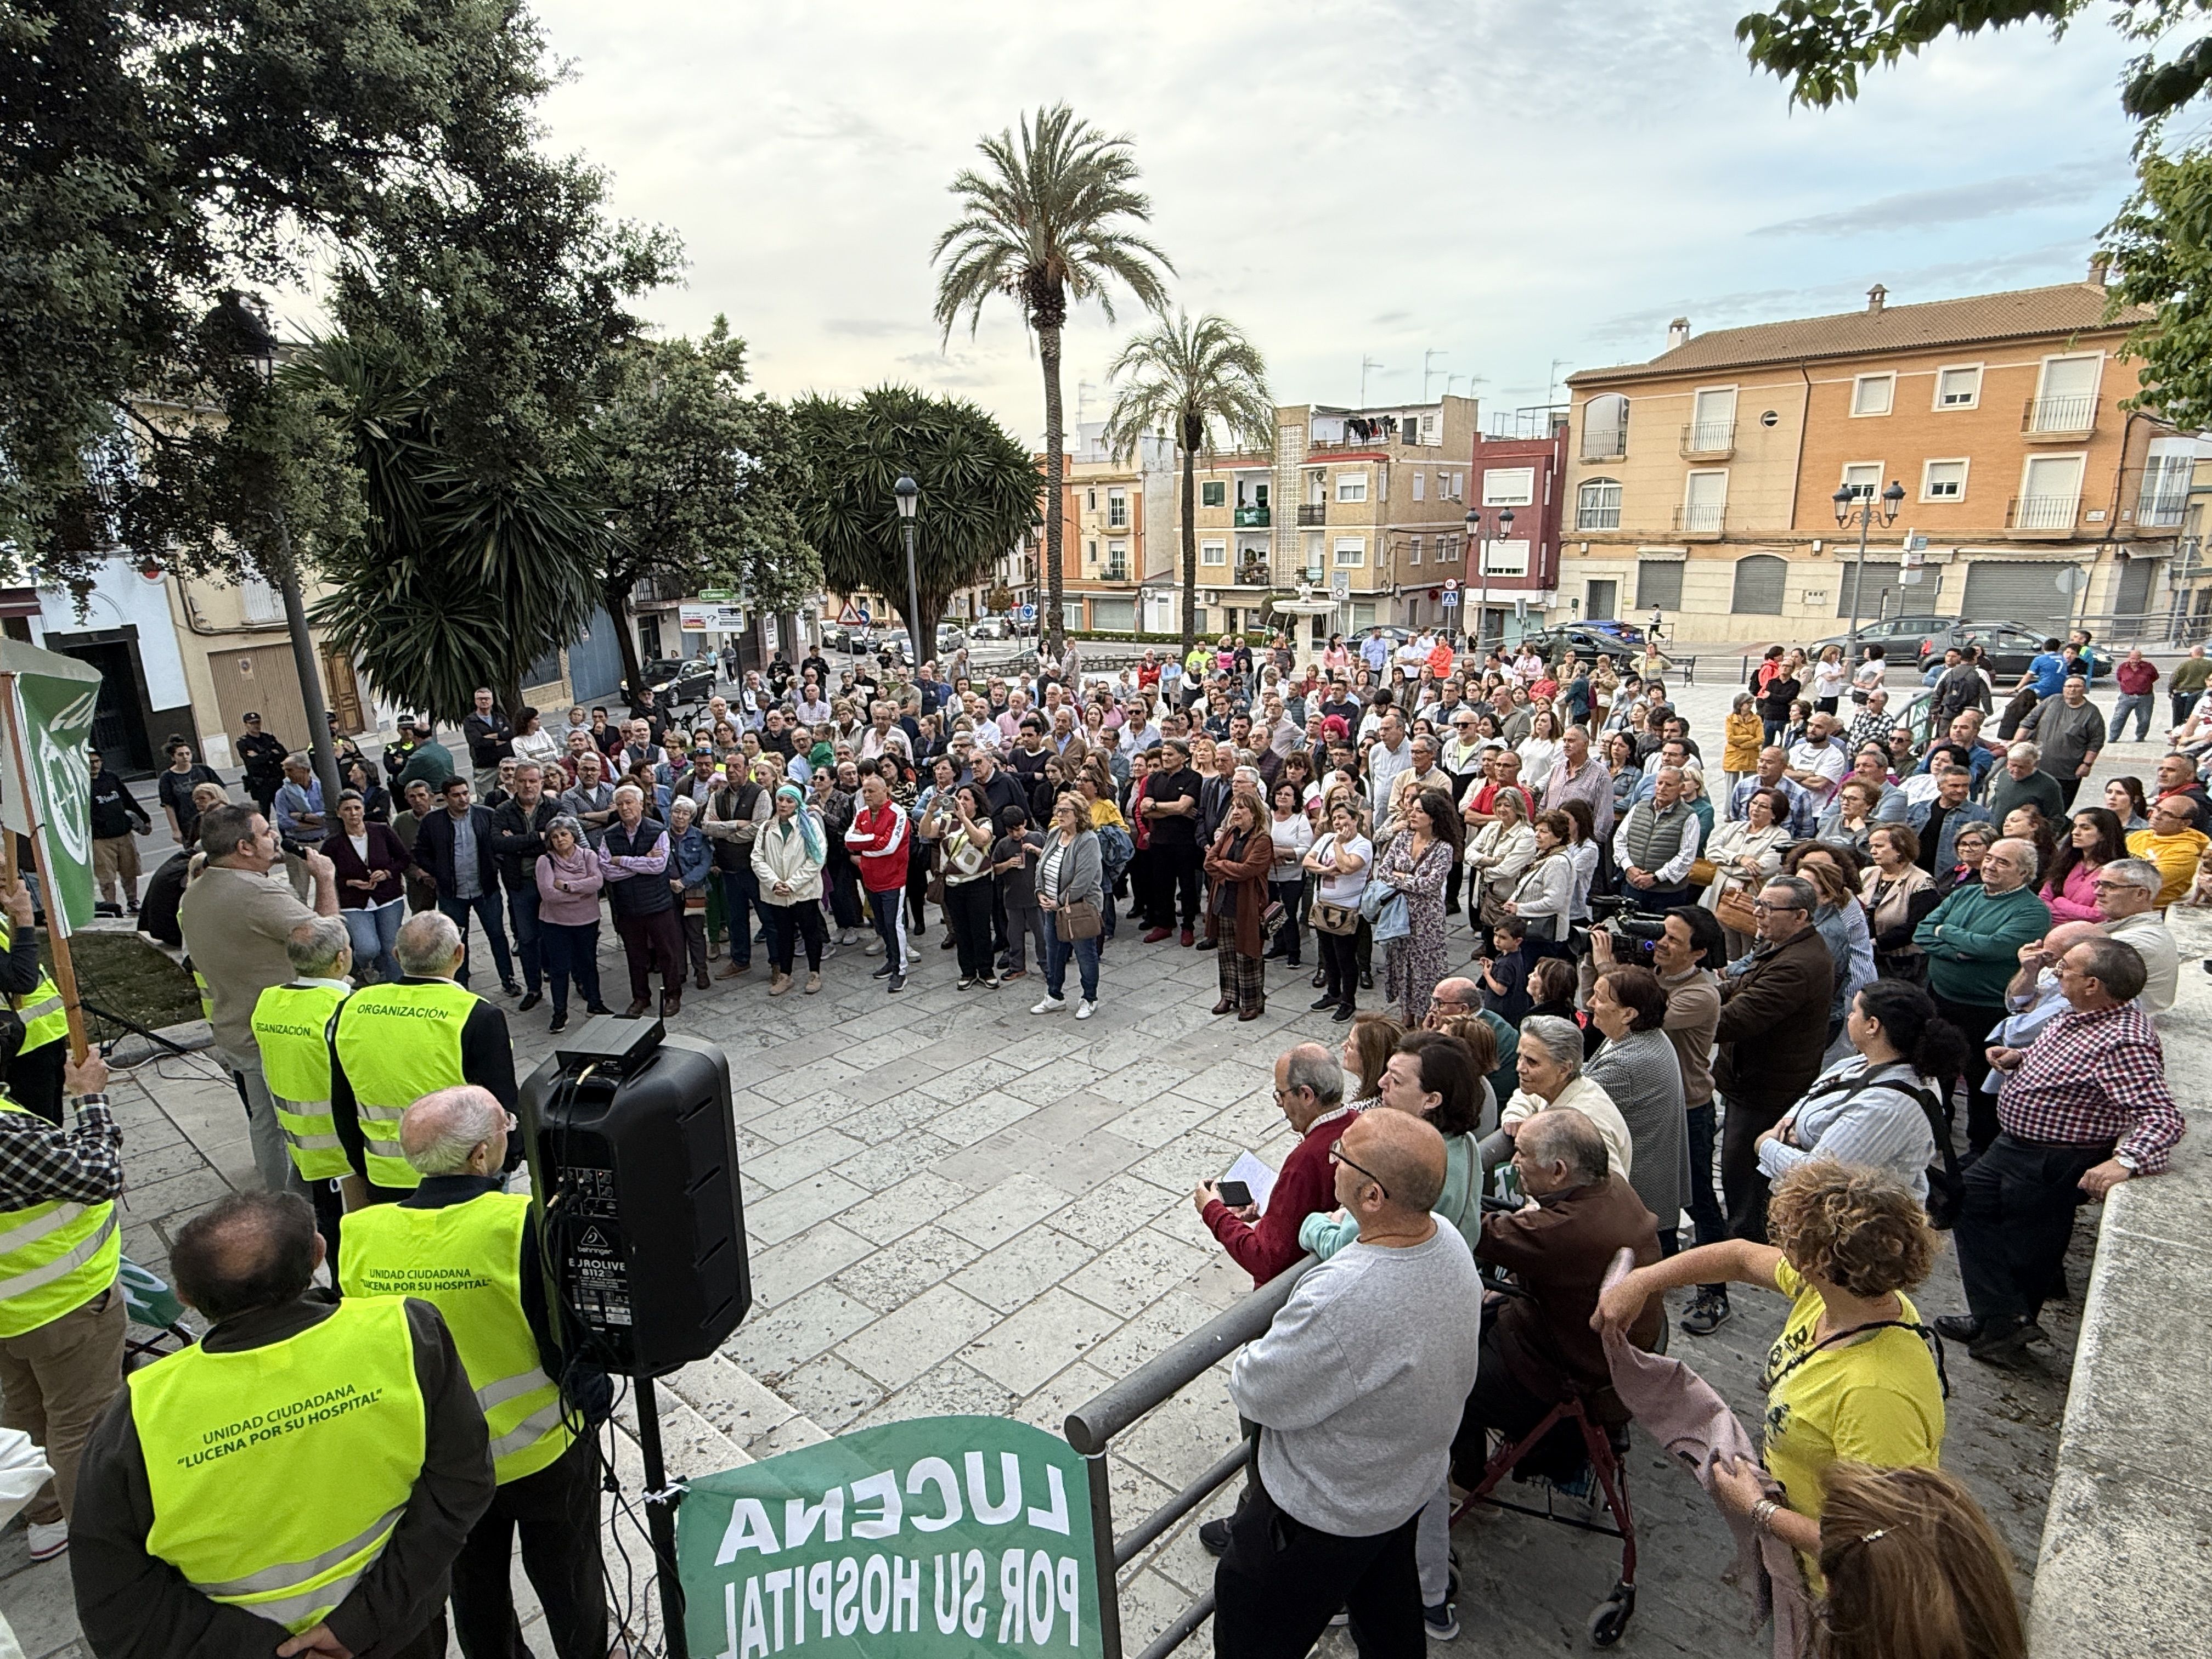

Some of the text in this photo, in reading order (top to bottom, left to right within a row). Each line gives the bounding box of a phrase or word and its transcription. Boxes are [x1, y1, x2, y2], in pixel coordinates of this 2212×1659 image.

[2055, 660, 2063, 673] 7
[357, 1004, 448, 1019] ORGANIZACIÓN
[577, 1246, 613, 1255] behringer
[370, 1269, 471, 1279] UNIDAD CIUDADANA
[394, 1282, 416, 1291] POR
[417, 1282, 432, 1291] SU
[203, 1384, 356, 1444] UNIDAD CIUDADANA
[250, 1425, 282, 1445] POR
[285, 1417, 304, 1433] SU
